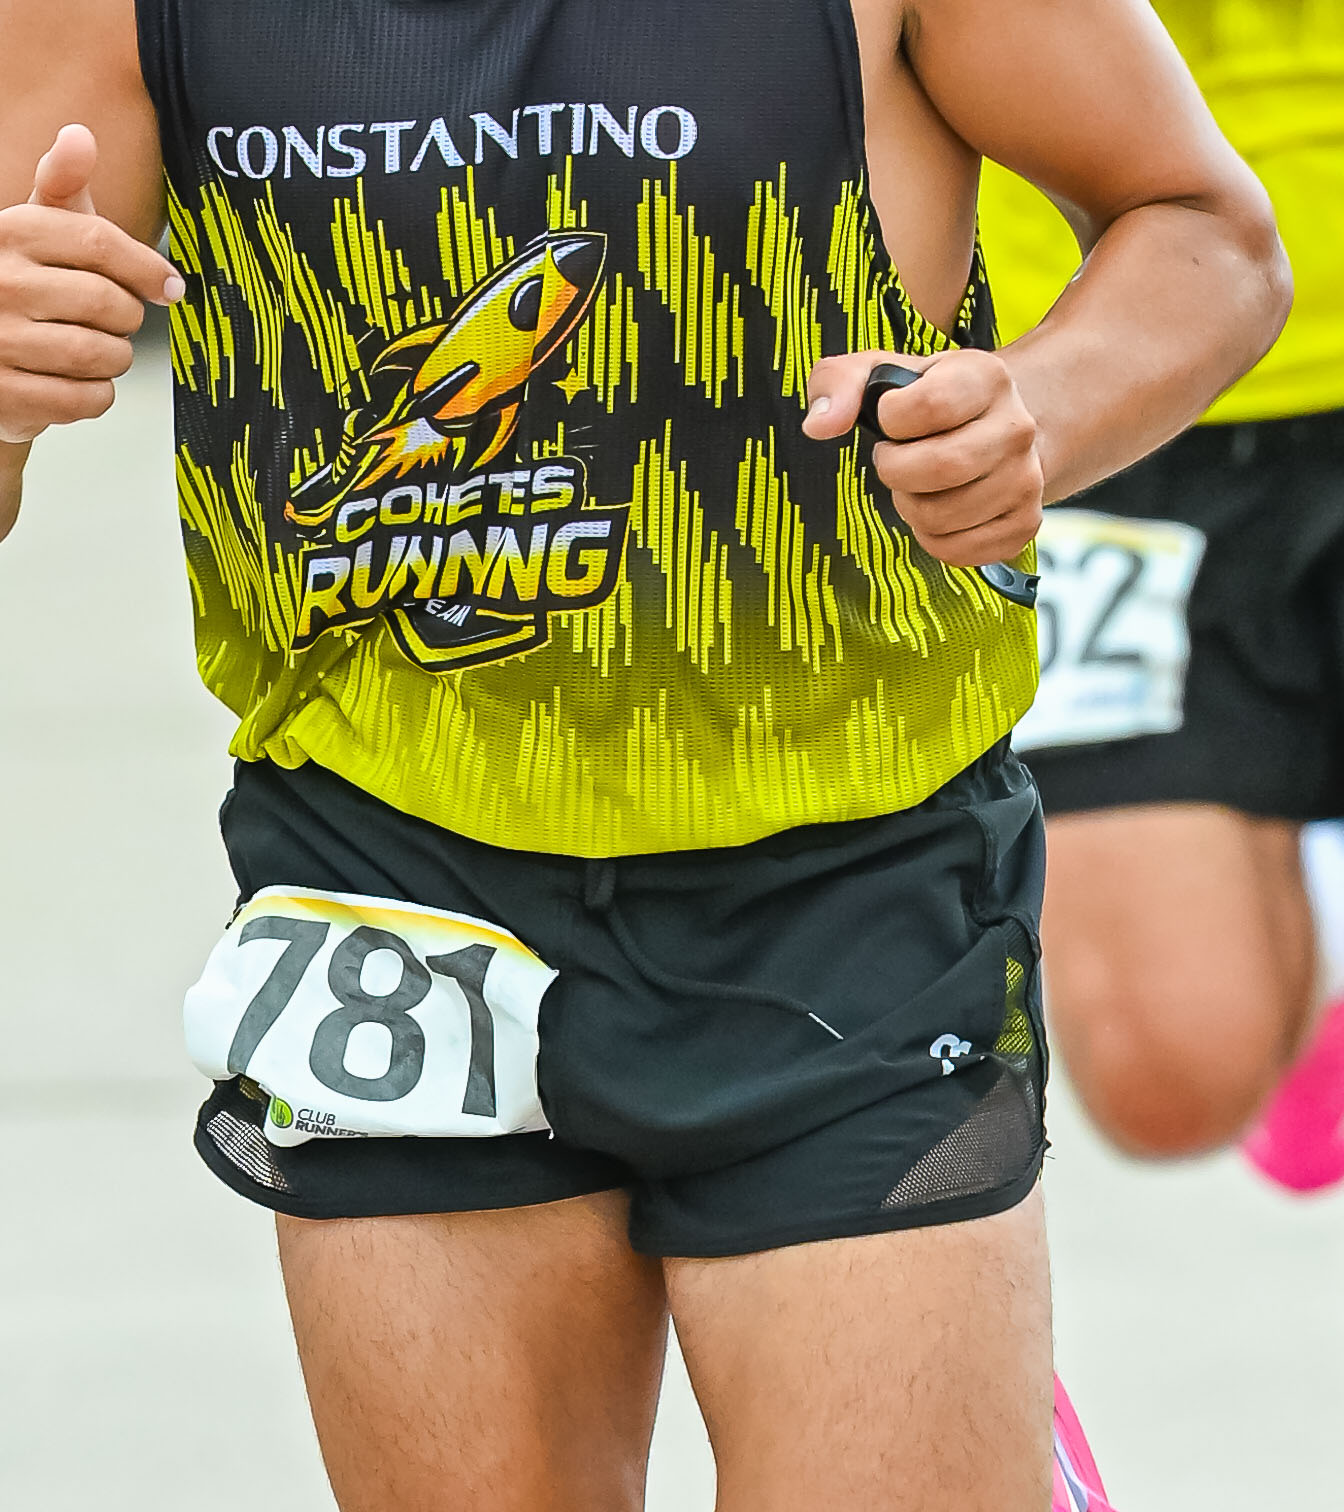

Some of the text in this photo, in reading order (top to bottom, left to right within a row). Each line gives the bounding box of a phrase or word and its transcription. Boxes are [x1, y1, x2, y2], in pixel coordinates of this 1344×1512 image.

[206, 102, 698, 179] CONSTANTINO
[296, 519, 612, 638] RUNNNG
[229, 914, 498, 1118] 781
[297, 1107, 337, 1126] CLUB
